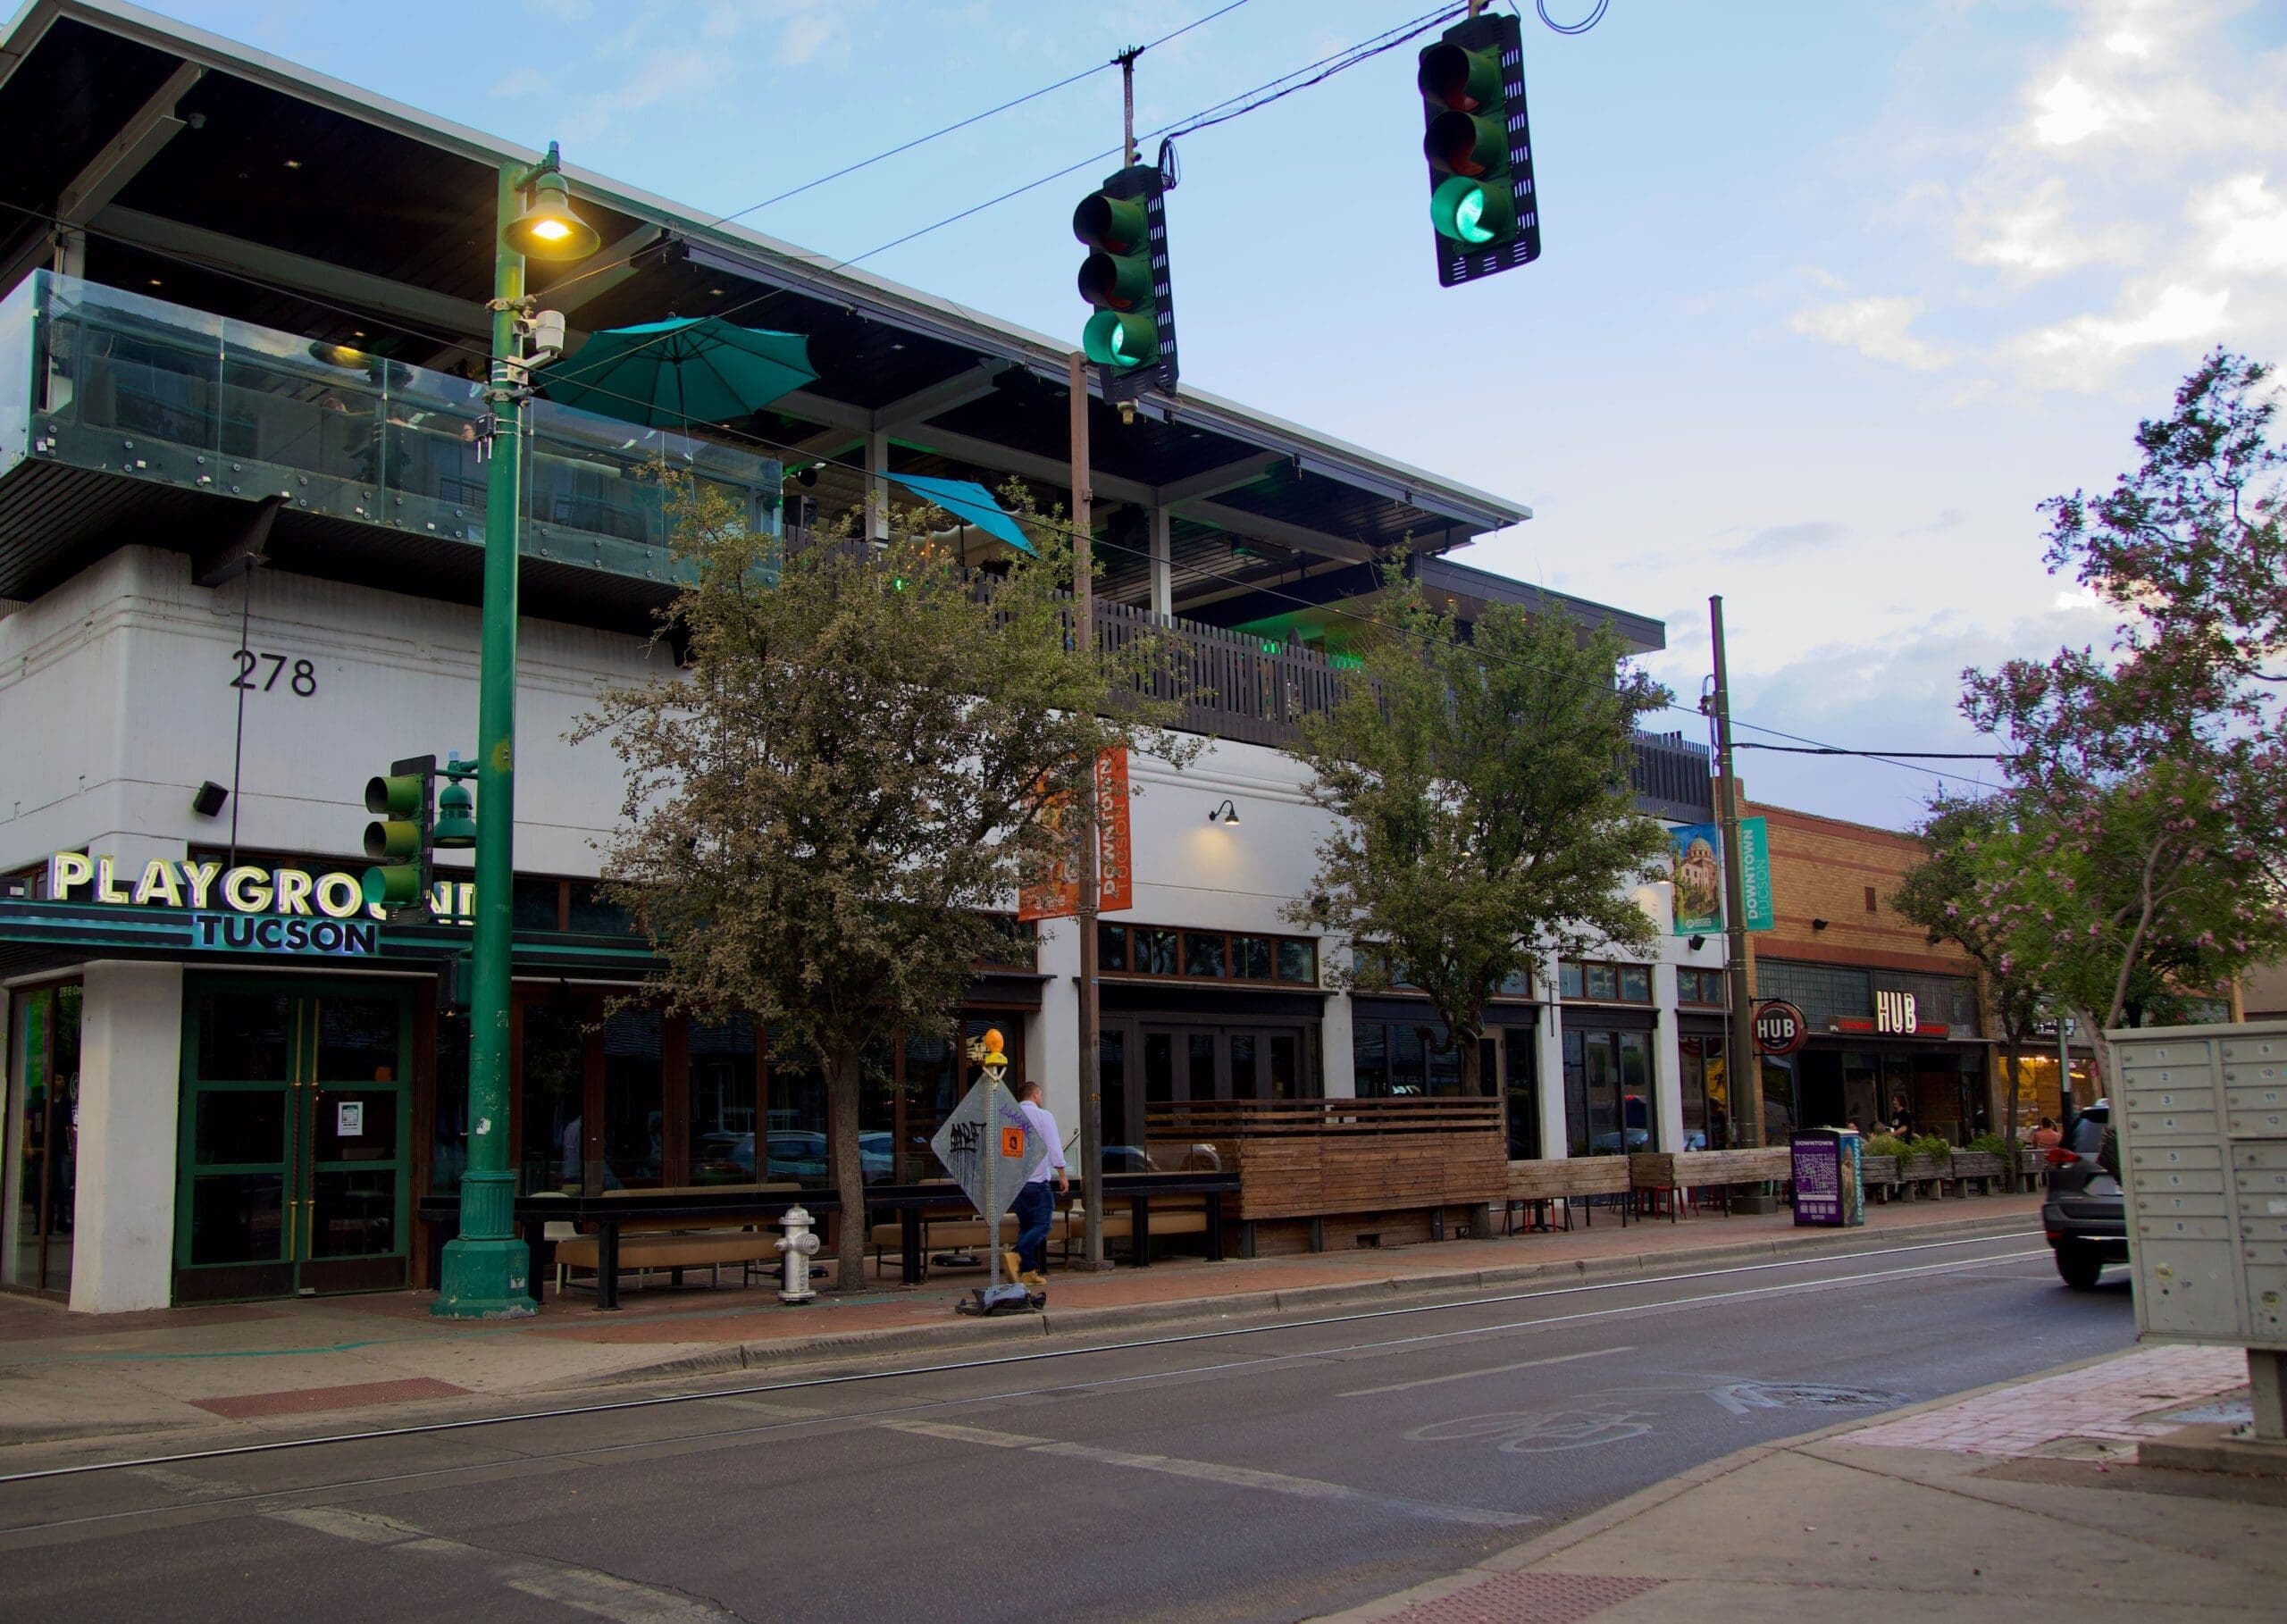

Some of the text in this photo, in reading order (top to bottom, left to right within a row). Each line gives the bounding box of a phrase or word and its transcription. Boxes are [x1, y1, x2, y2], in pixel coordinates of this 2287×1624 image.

[230, 650, 316, 697] 278
[1743, 829, 1758, 919] DOWNTOWN
[1756, 859, 1770, 917] TUCSON
[196, 915, 375, 952] TUCSON
[1757, 1019, 1795, 1038] HUB
[1877, 991, 1917, 1034] HUB
